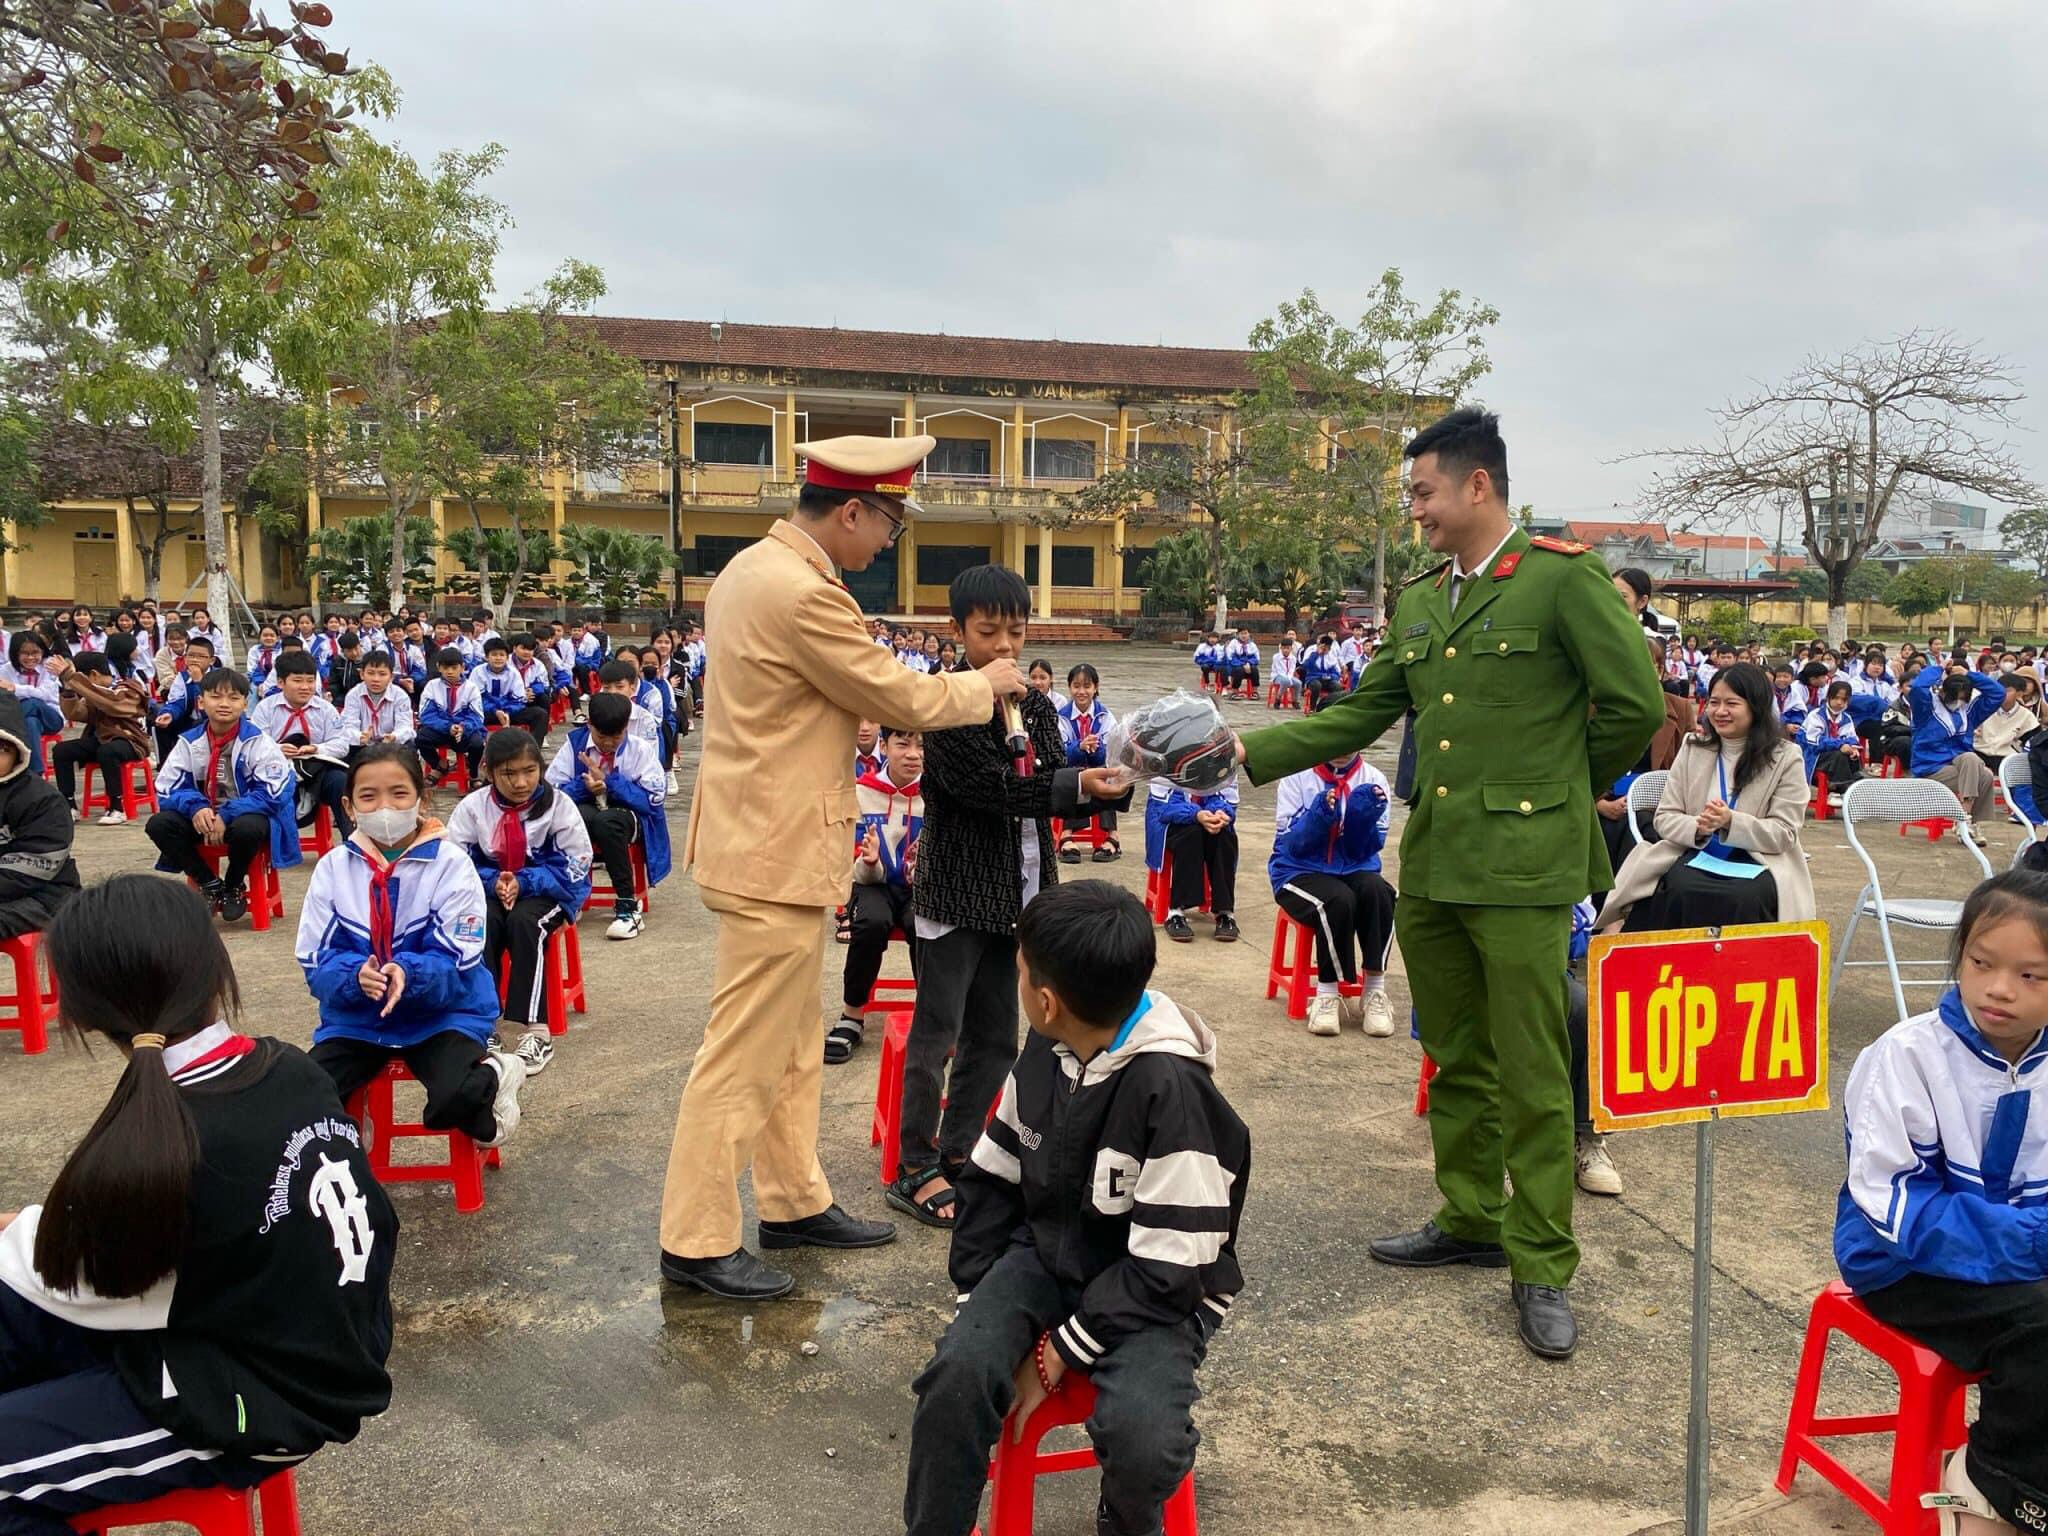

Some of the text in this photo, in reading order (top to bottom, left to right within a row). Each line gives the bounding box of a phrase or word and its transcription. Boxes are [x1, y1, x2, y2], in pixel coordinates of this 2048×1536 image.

[1615, 964, 1805, 1095] LỚP 7A
[314, 1116, 331, 1141] and
